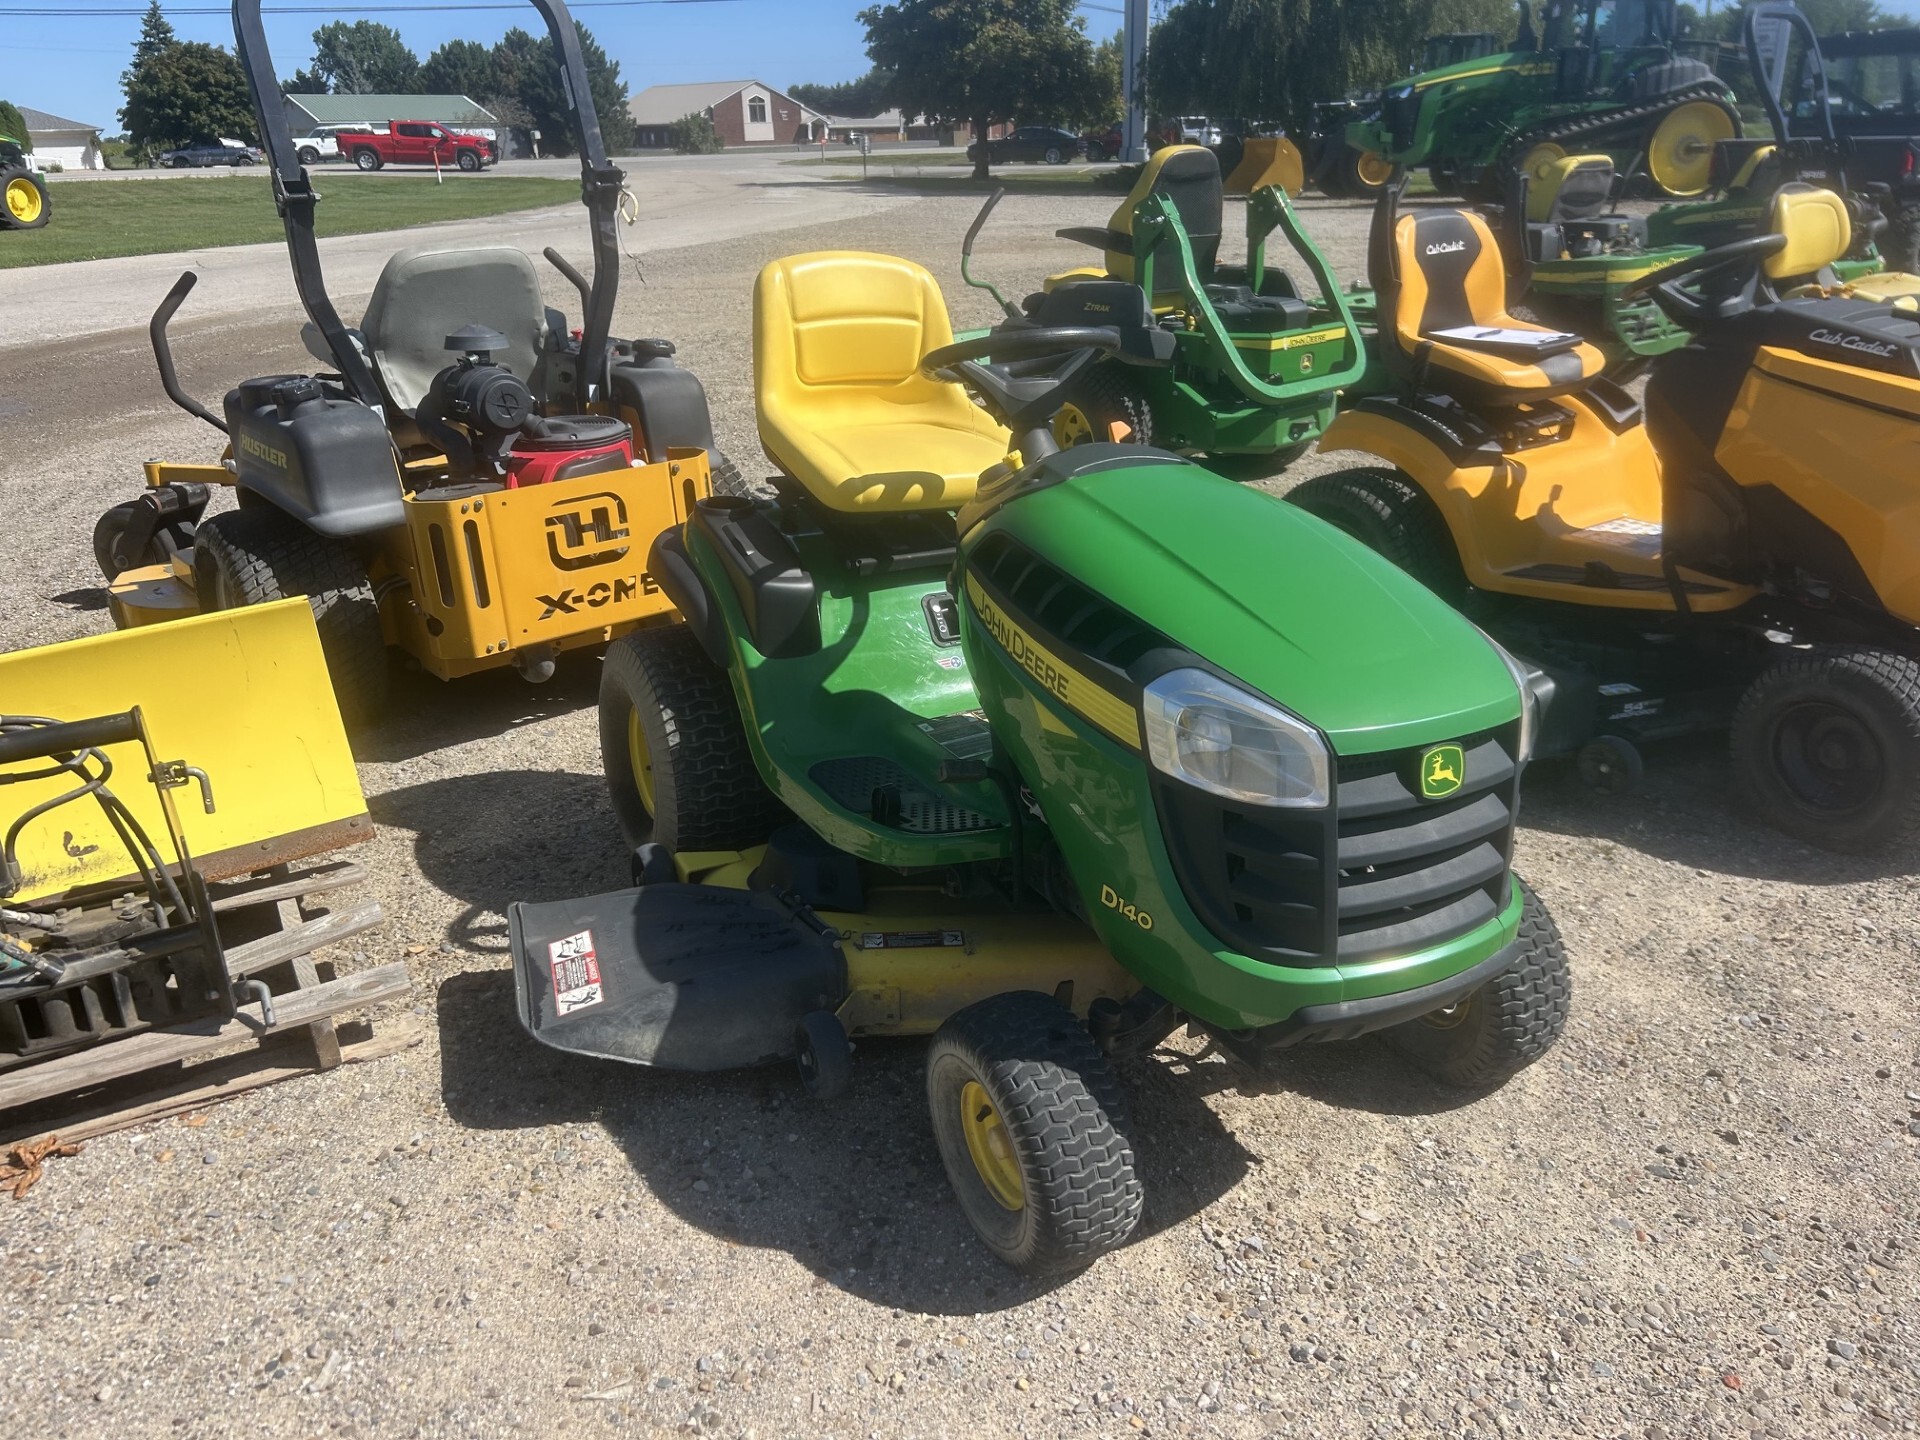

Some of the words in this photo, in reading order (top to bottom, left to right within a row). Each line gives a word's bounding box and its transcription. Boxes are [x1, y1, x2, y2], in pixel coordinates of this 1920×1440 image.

[1809, 328, 1842, 345] Cub
[1841, 335, 1899, 357] Cadet
[241, 433, 288, 469] HUSTLER
[535, 572, 659, 621] X-ONE
[978, 593, 1011, 652] JOHN
[1012, 630, 1070, 701] DEERE
[1101, 884, 1153, 930] D140
